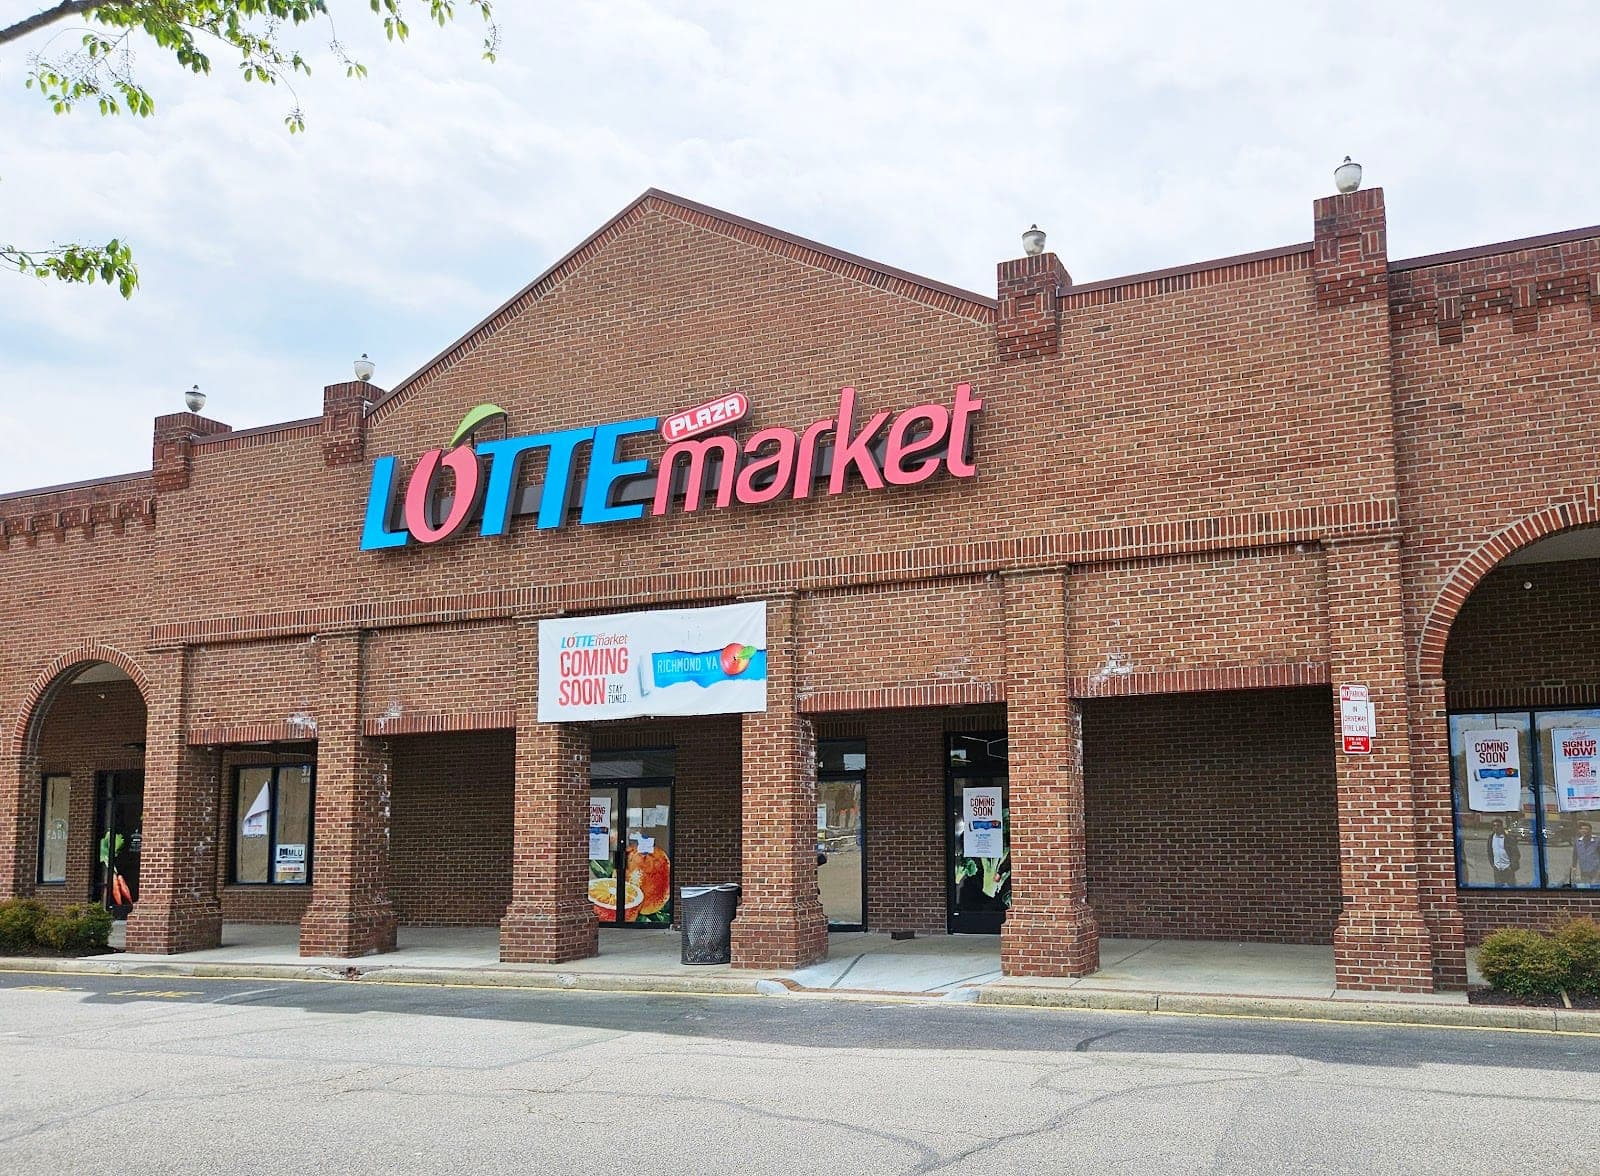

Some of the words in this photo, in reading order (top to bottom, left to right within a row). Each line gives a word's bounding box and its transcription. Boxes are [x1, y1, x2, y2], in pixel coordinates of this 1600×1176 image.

[670, 398, 741, 437] PLAZA
[360, 417, 659, 550] LOTTE
[653, 383, 983, 515] market
[561, 635, 596, 649] LOTTE
[595, 634, 629, 647] market
[560, 647, 629, 678] COMING
[706, 655, 719, 671] VA
[558, 677, 606, 707] SOON
[608, 684, 624, 694] STAY
[1474, 741, 1509, 753] COMING
[1562, 740, 1583, 748] SIGN
[1584, 739, 1597, 747] UP
[1479, 751, 1506, 764] SOON
[1563, 746, 1597, 757] NOW!
[970, 797, 996, 807] COMING
[973, 806, 993, 817] SOON
